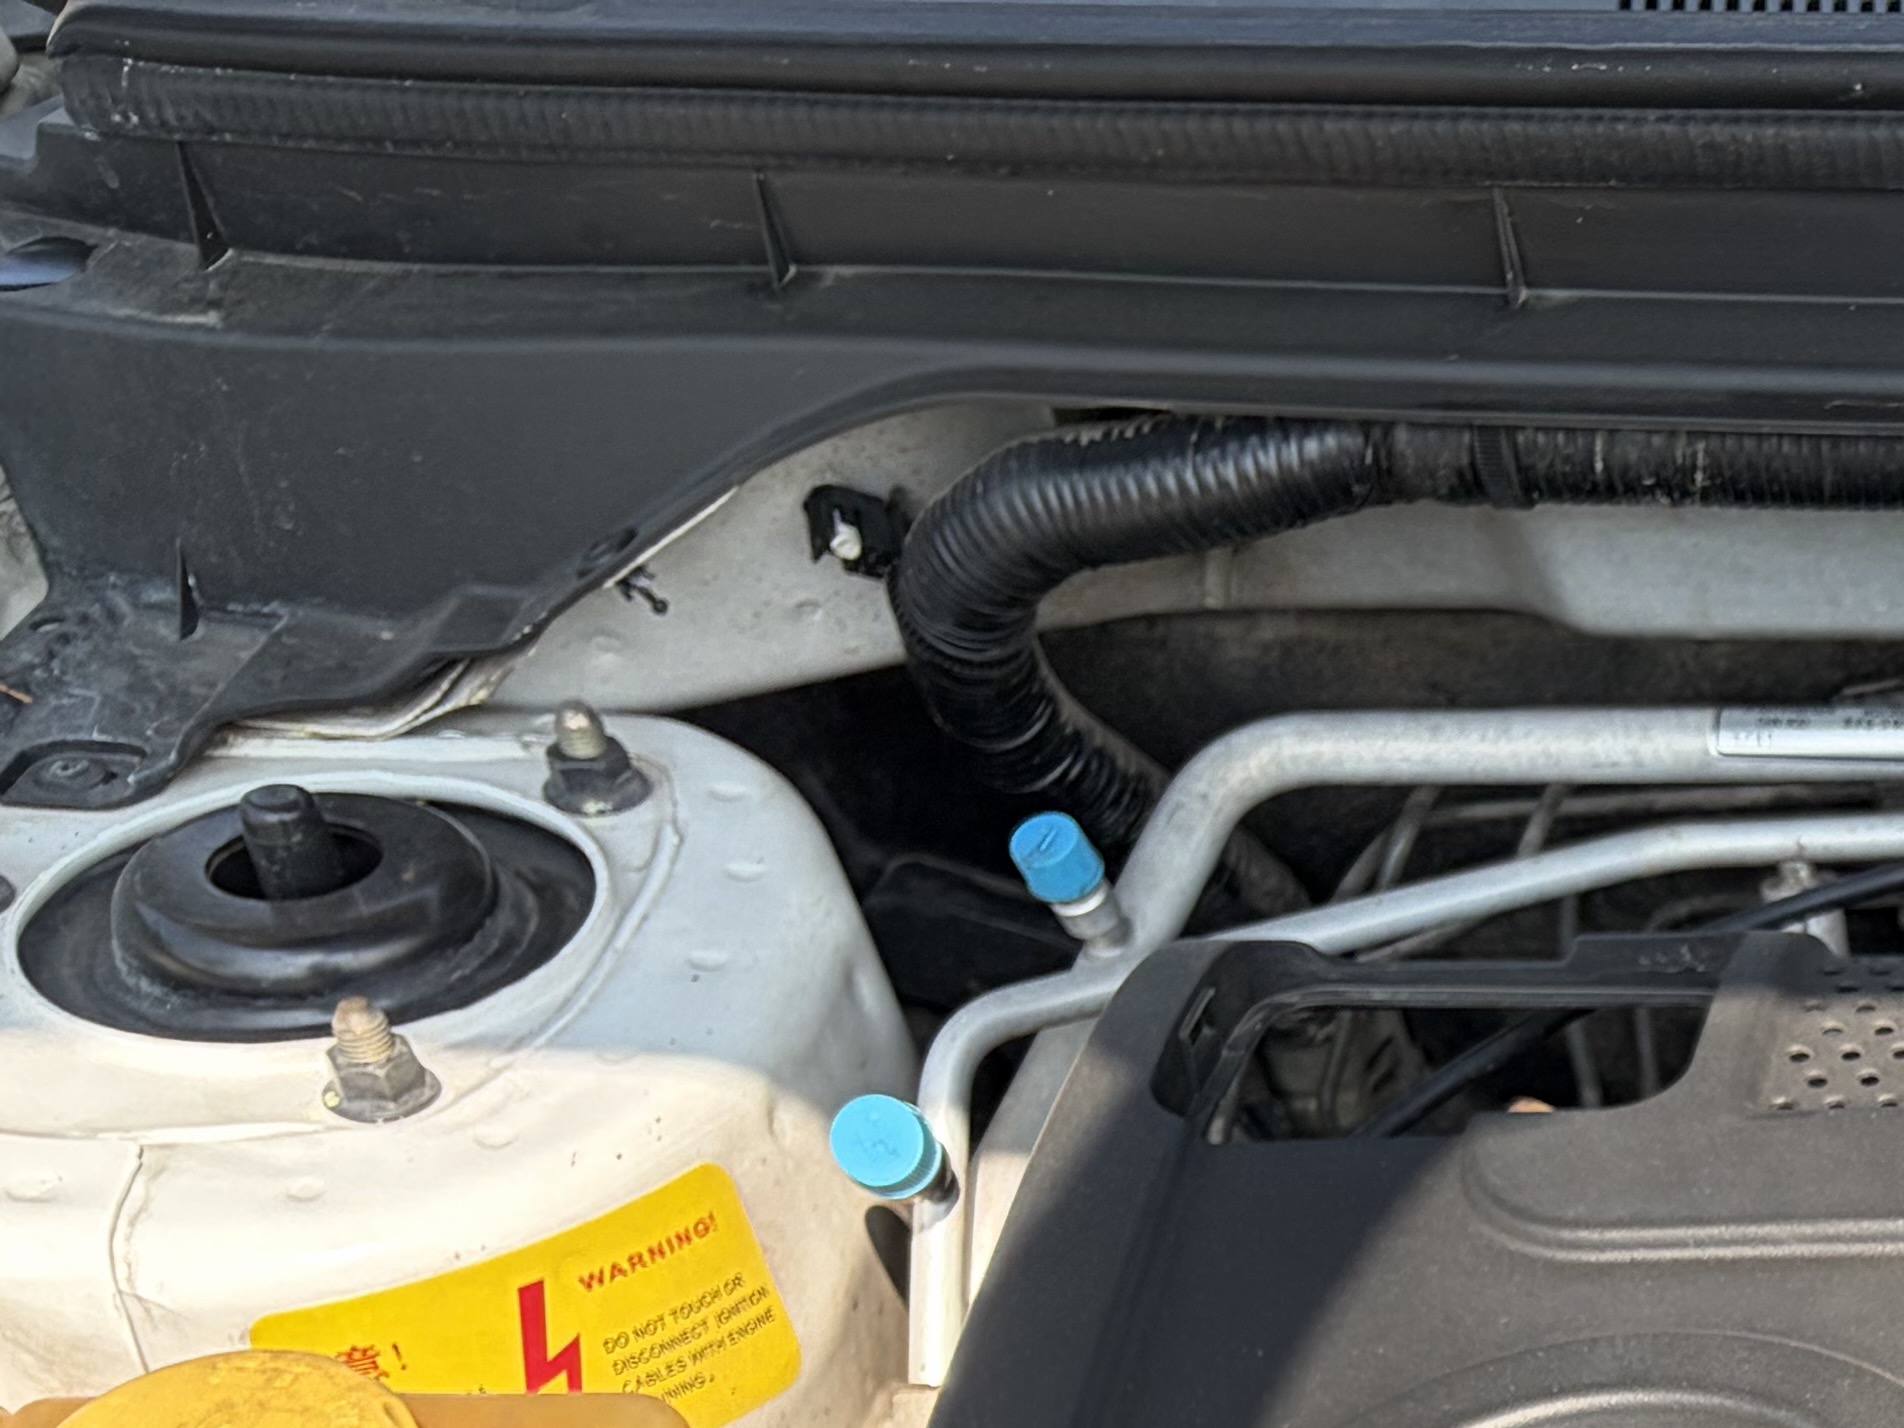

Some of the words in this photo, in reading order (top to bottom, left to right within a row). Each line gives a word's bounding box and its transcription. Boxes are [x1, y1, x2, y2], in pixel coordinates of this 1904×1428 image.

[579, 1211, 717, 1292] WARNING!
[603, 1332, 630, 1354] DO
[633, 1313, 666, 1343] NOT
[668, 1285, 722, 1320] TOUCH
[723, 1272, 746, 1296] OR
[612, 1320, 710, 1376] DISCONNECT
[714, 1283, 770, 1329] IGNITION
[622, 1356, 687, 1393] CABLES
[689, 1337, 727, 1366] WITH
[729, 1305, 775, 1345] ENGINE
